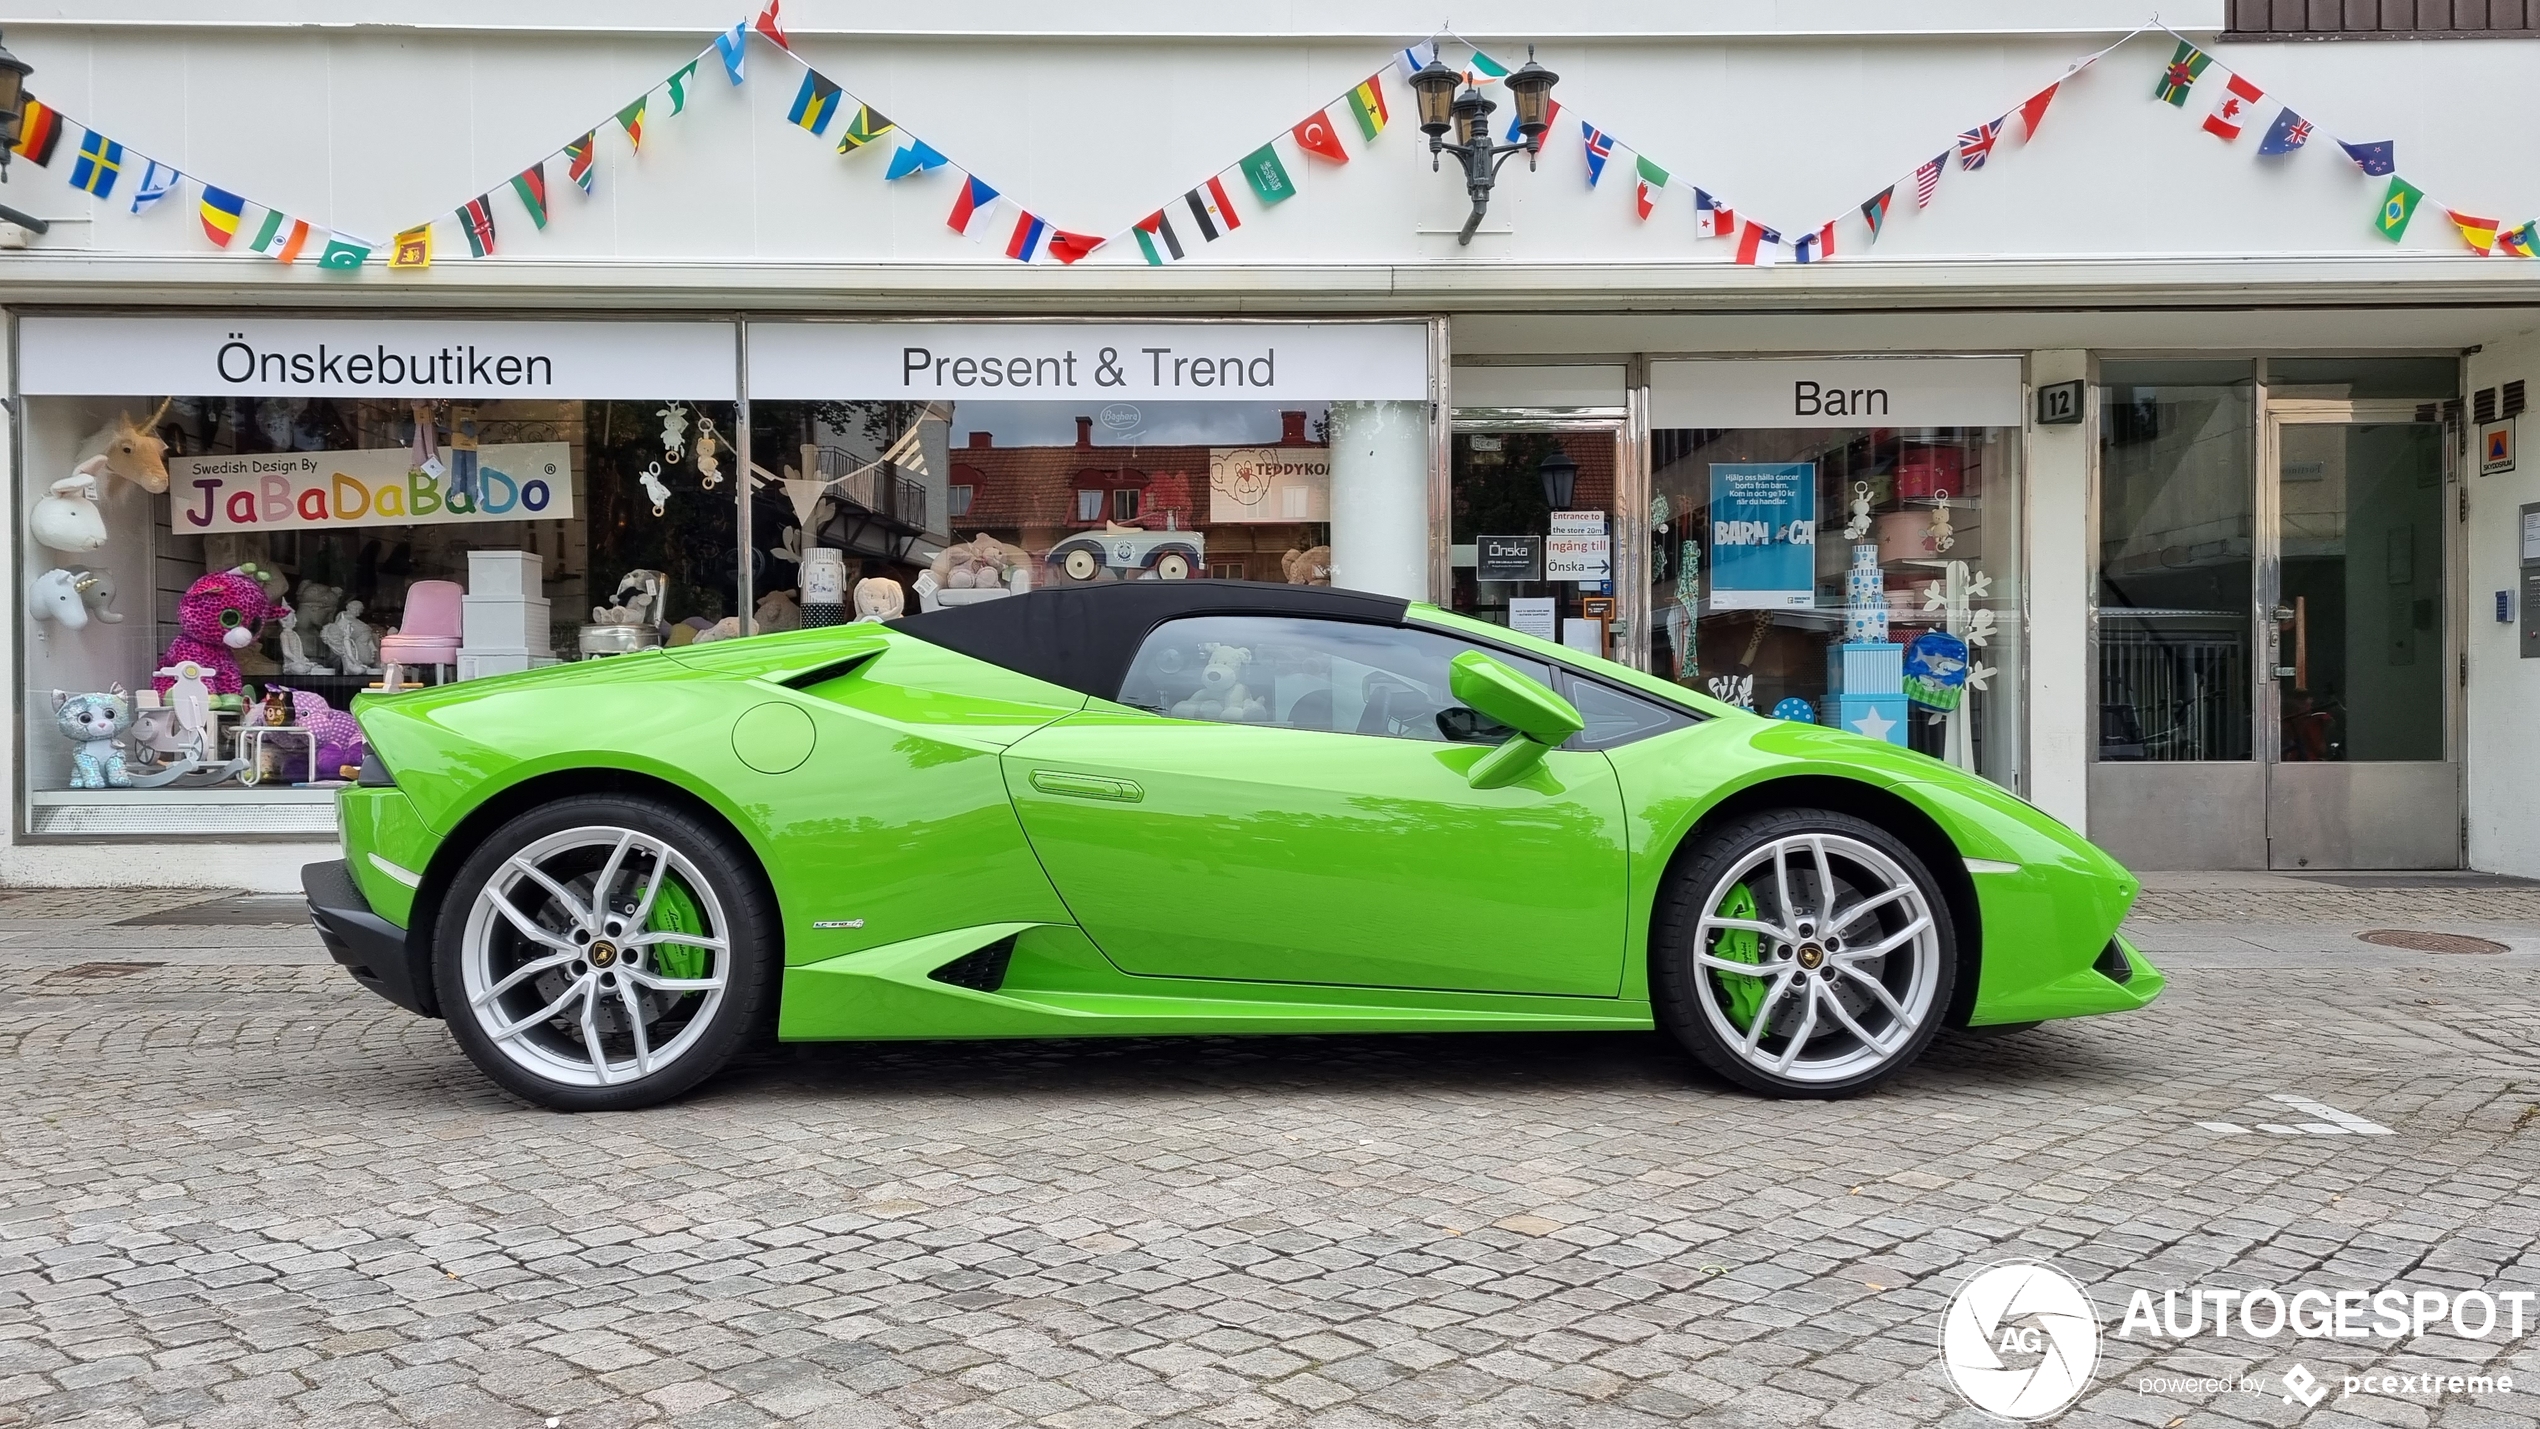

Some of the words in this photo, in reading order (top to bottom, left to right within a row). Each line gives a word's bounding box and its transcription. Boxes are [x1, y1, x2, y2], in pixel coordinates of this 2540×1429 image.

[216, 333, 553, 388] Önskebutiken
[903, 347, 1077, 388] Present
[1094, 347, 1127, 388] &
[1142, 347, 1275, 388] Trend
[1794, 380, 1889, 417] Barn
[2048, 390, 2070, 416] 12
[192, 461, 248, 475] Swedish
[252, 459, 297, 475] Design
[301, 458, 318, 474] By
[2483, 459, 2513, 471] SKYDDSRUM
[1725, 473, 1744, 483] Hjälp
[1757, 473, 1774, 481] hålla
[1755, 481, 1770, 489] från
[1553, 512, 1589, 520] Entrance
[1552, 526, 1566, 534] the
[1714, 520, 1769, 545] BARN
[1788, 519, 1814, 545] CA
[1489, 541, 1528, 557] Önska
[1548, 540, 1588, 553] Ingång
[1591, 540, 1607, 551] till
[1548, 559, 1585, 572] Önska
